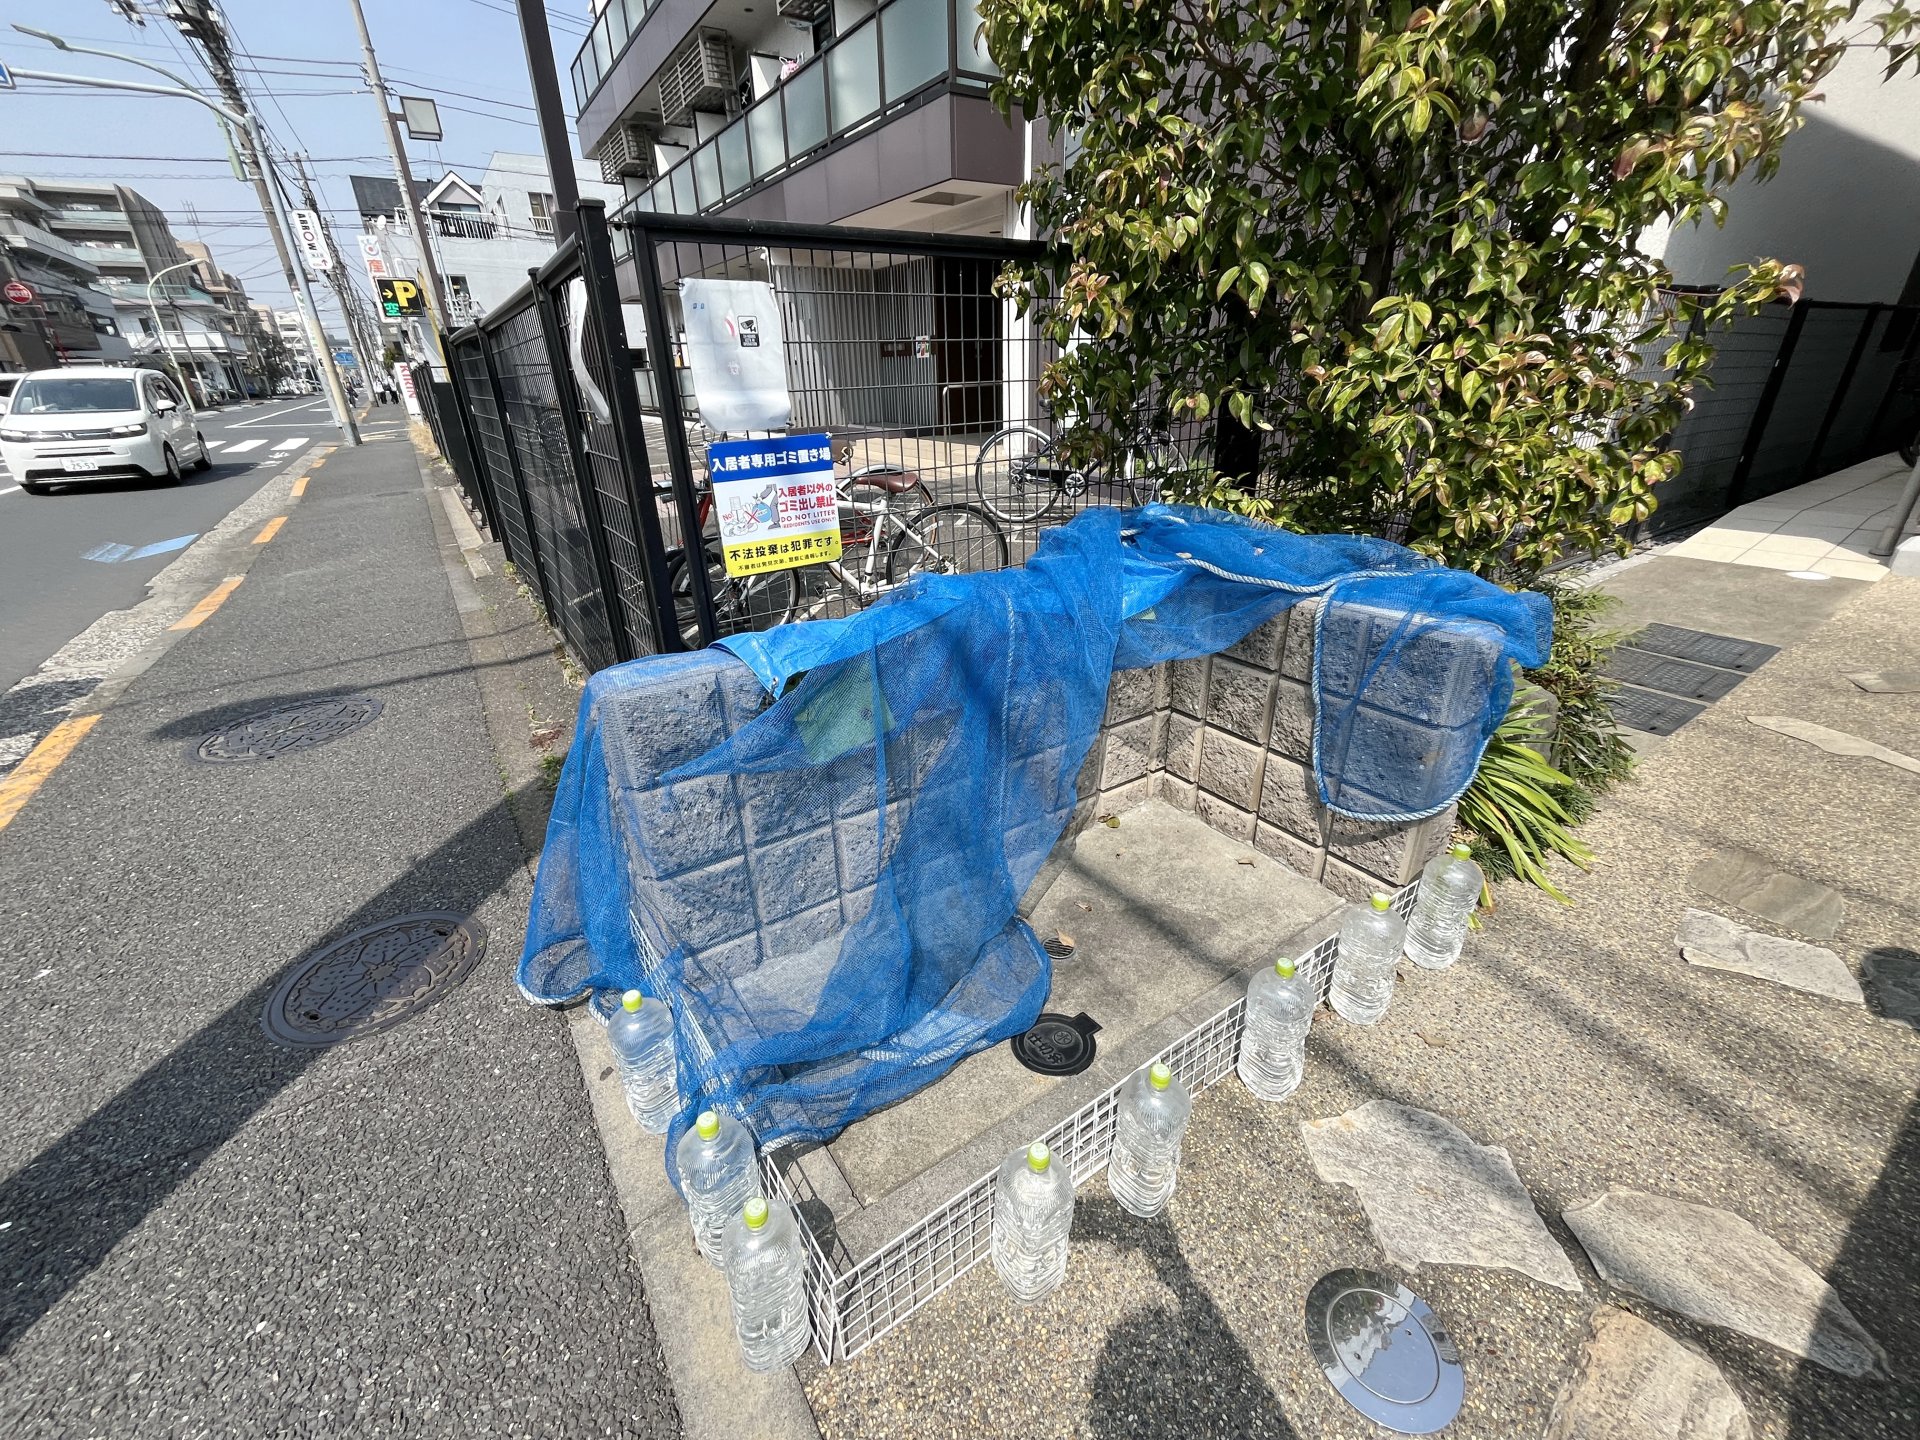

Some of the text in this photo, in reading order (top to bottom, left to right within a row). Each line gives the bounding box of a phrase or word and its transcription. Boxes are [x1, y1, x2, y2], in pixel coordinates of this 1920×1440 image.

[297, 212, 317, 251] ARROW
[393, 281, 416, 307] P
[712, 447, 831, 473] 入居者専用ゴミ置き場
[778, 483, 833, 498] 入居者以外の
[779, 495, 835, 513] ゴミ出し禁止
[795, 513, 811, 521] NOT
[813, 509, 836, 518] LITTER
[729, 536, 839, 561] 不法投棄は犯罪です。
